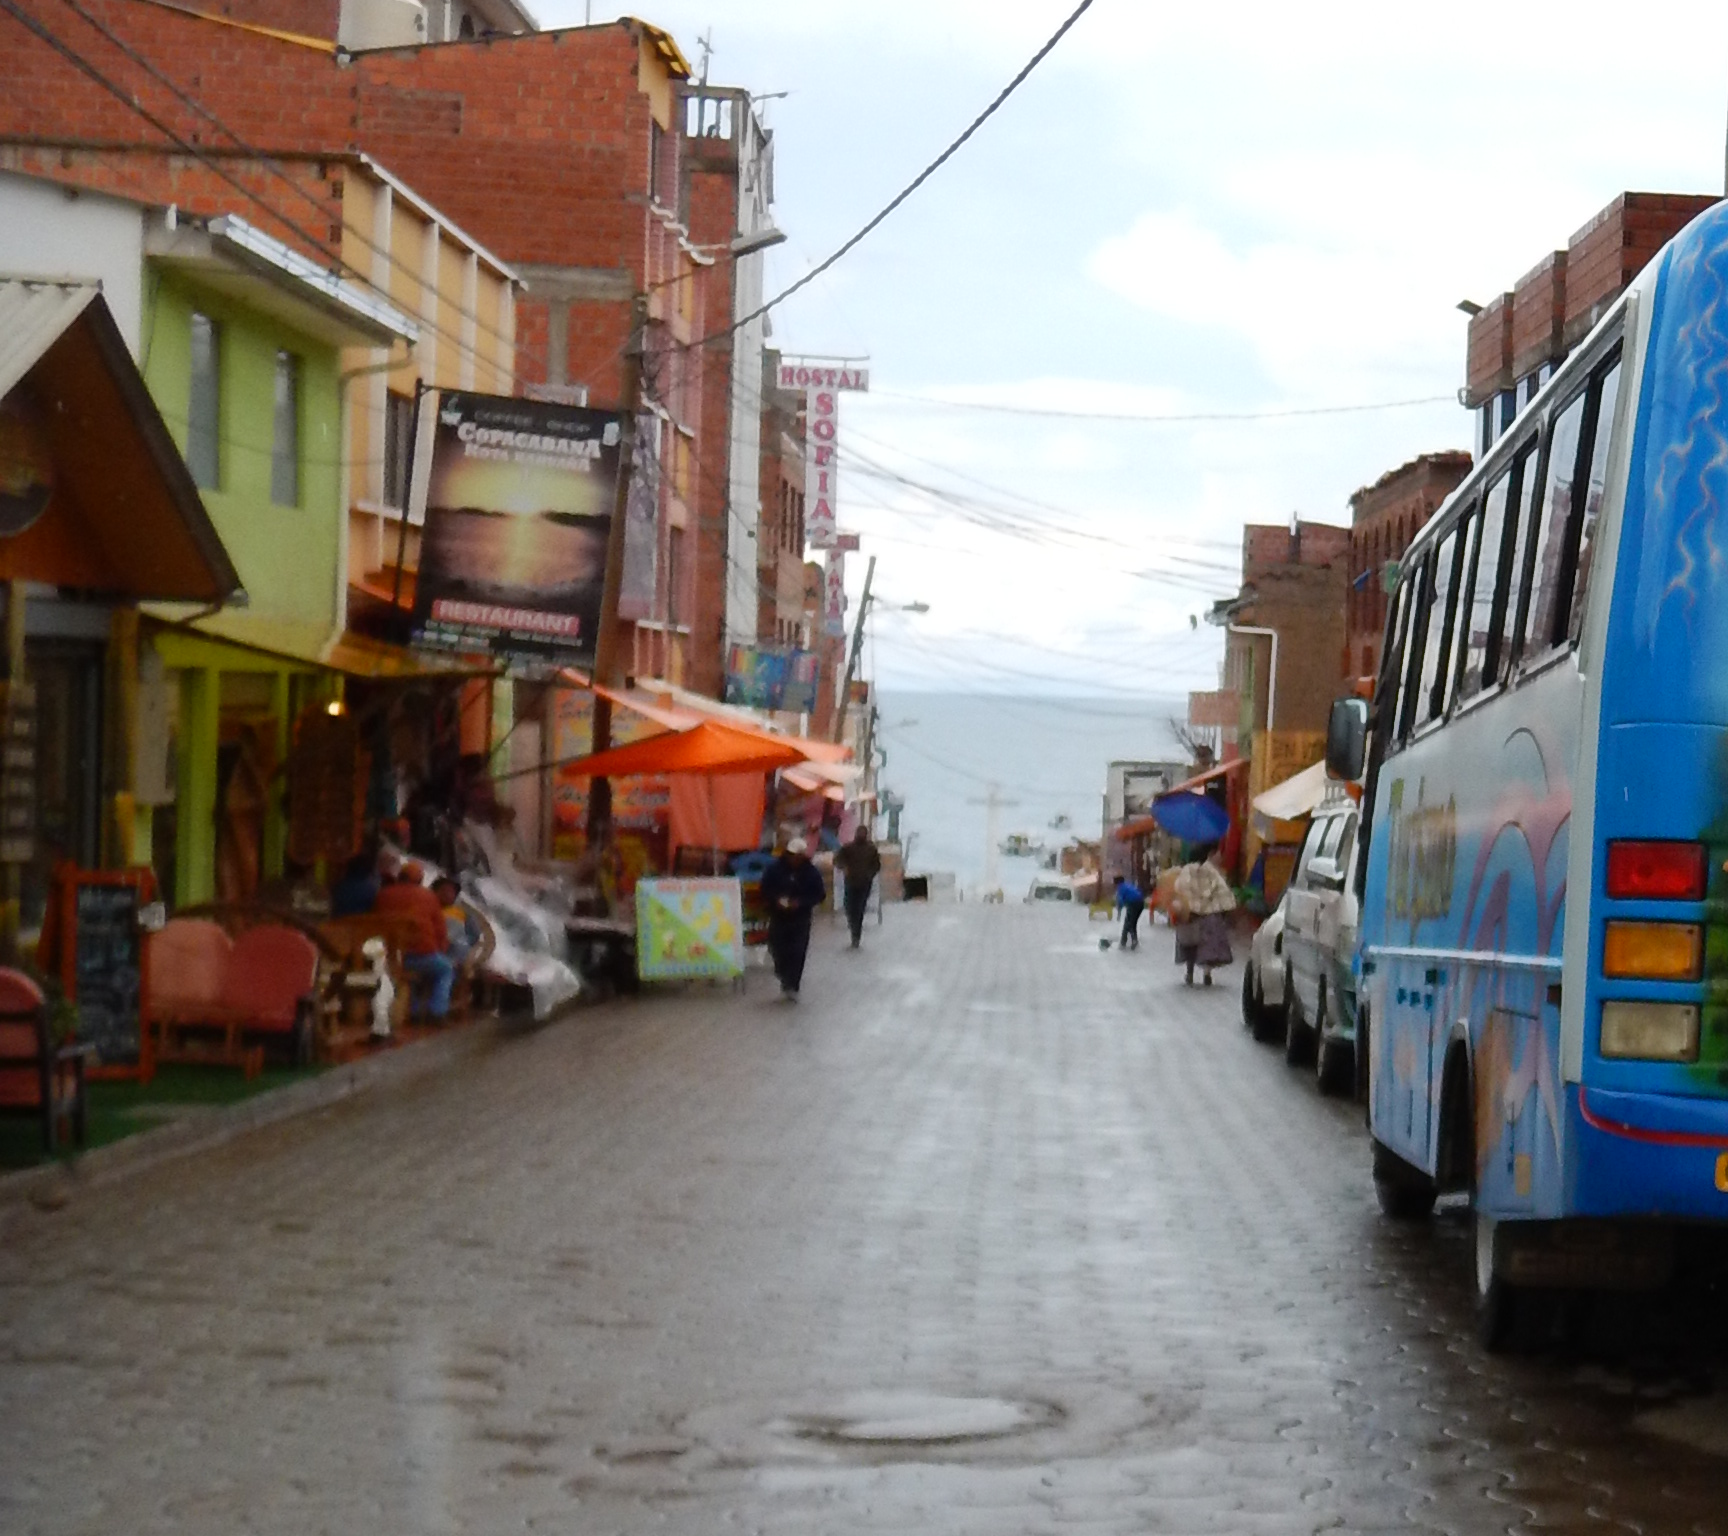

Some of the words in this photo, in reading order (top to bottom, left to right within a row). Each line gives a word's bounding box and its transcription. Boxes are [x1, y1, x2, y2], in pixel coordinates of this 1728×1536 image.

[780, 366, 866, 391] HOSTAL
[812, 392, 836, 520] SOFIA
[439, 599, 576, 632] RESTAURANT
